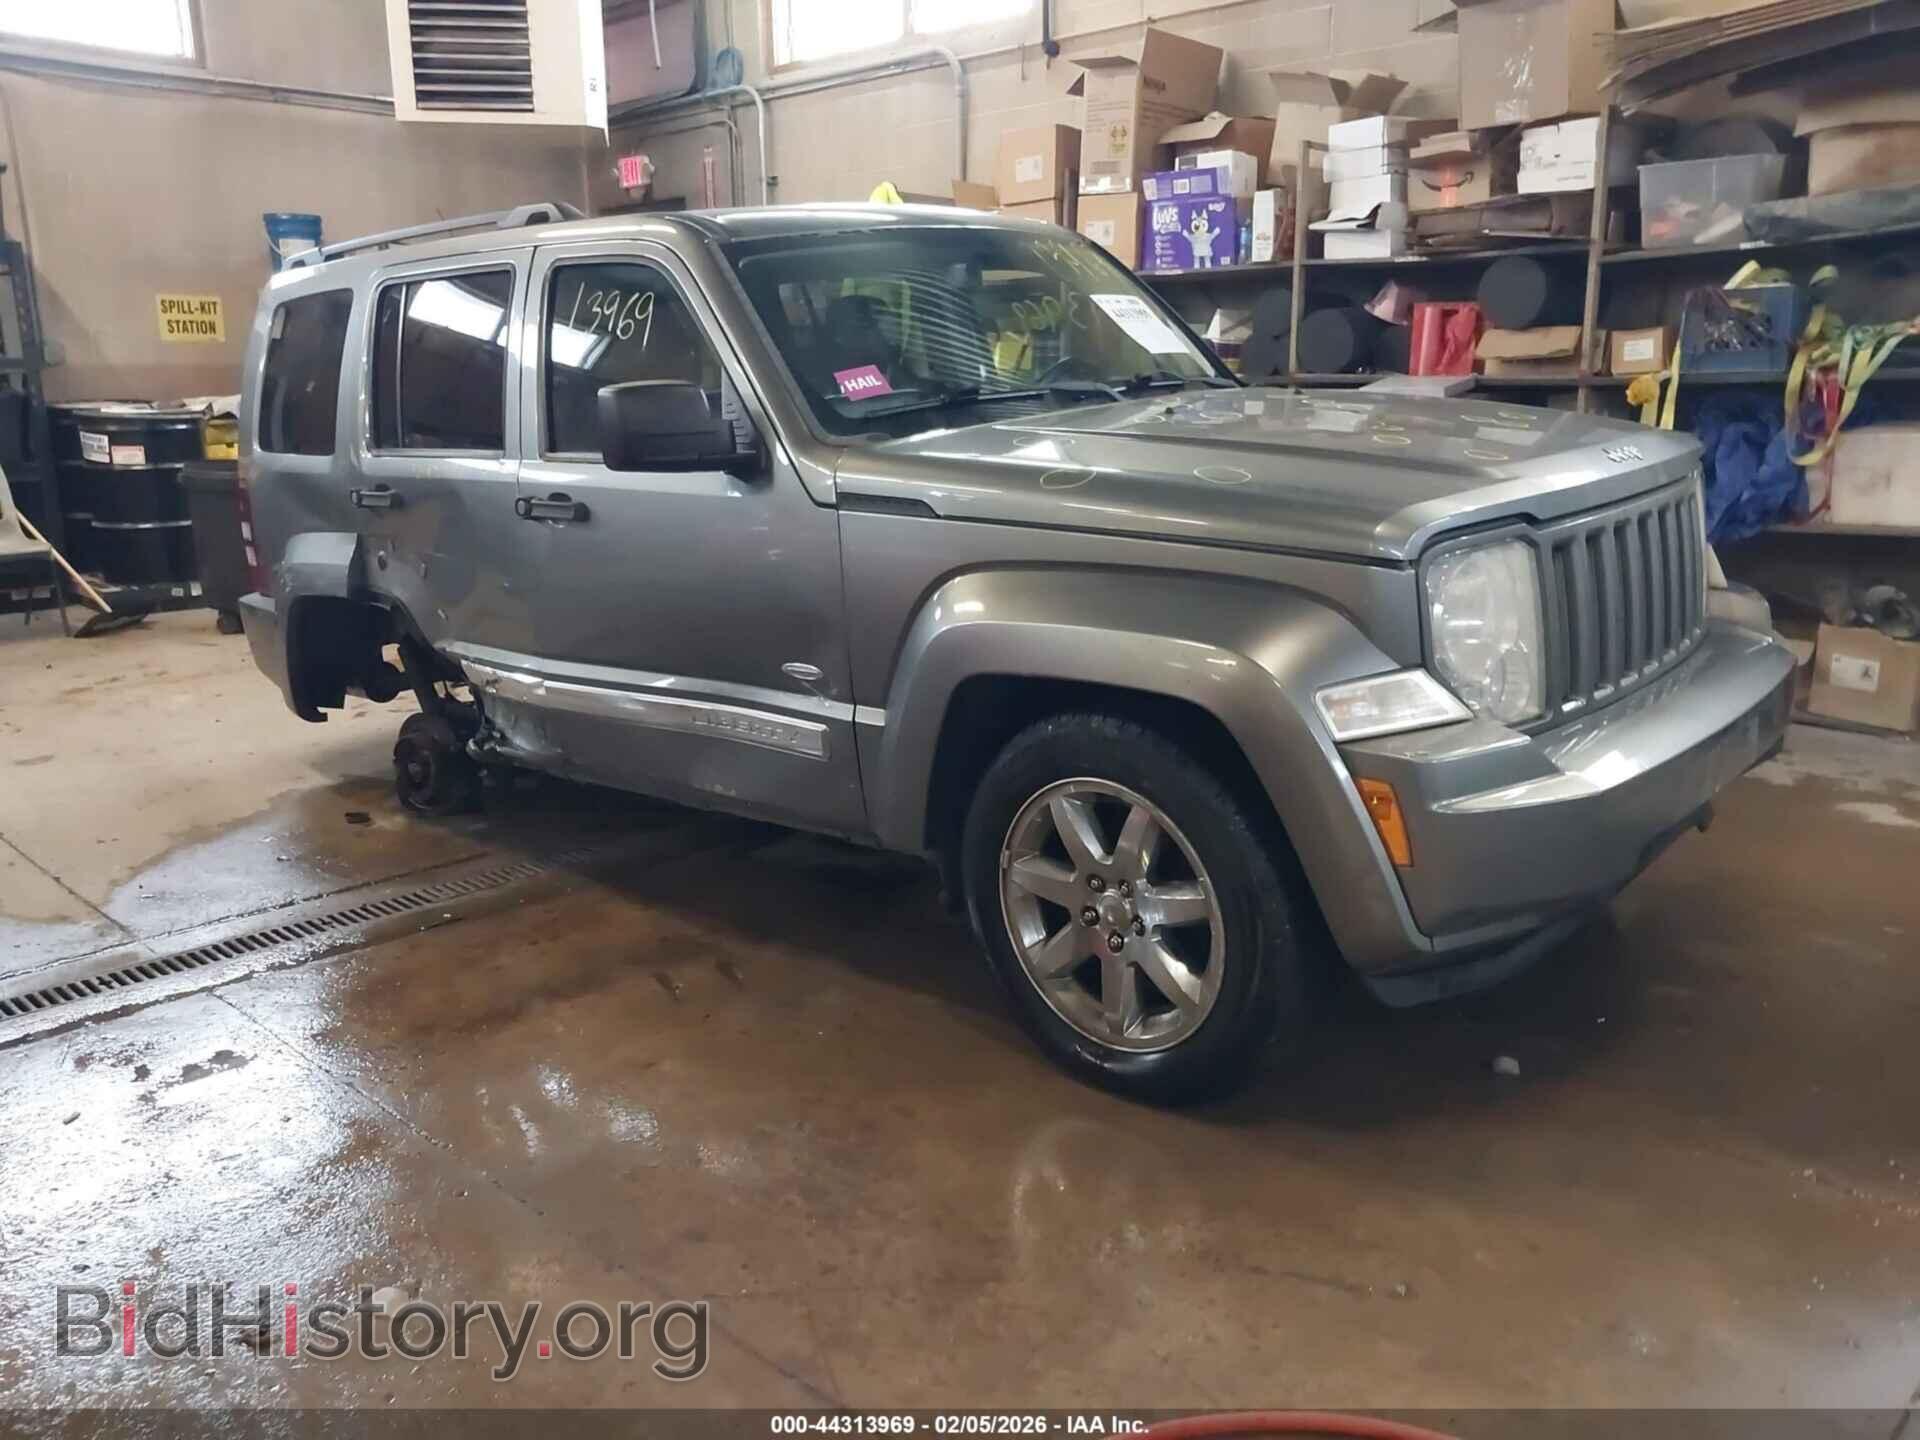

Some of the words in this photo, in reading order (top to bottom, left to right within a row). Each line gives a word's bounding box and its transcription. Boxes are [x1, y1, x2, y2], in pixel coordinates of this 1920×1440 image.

[160, 299, 217, 315] SPILL-KIT
[568, 281, 655, 350] 13969
[167, 319, 217, 336] STATION
[844, 375, 883, 392] HAIL
